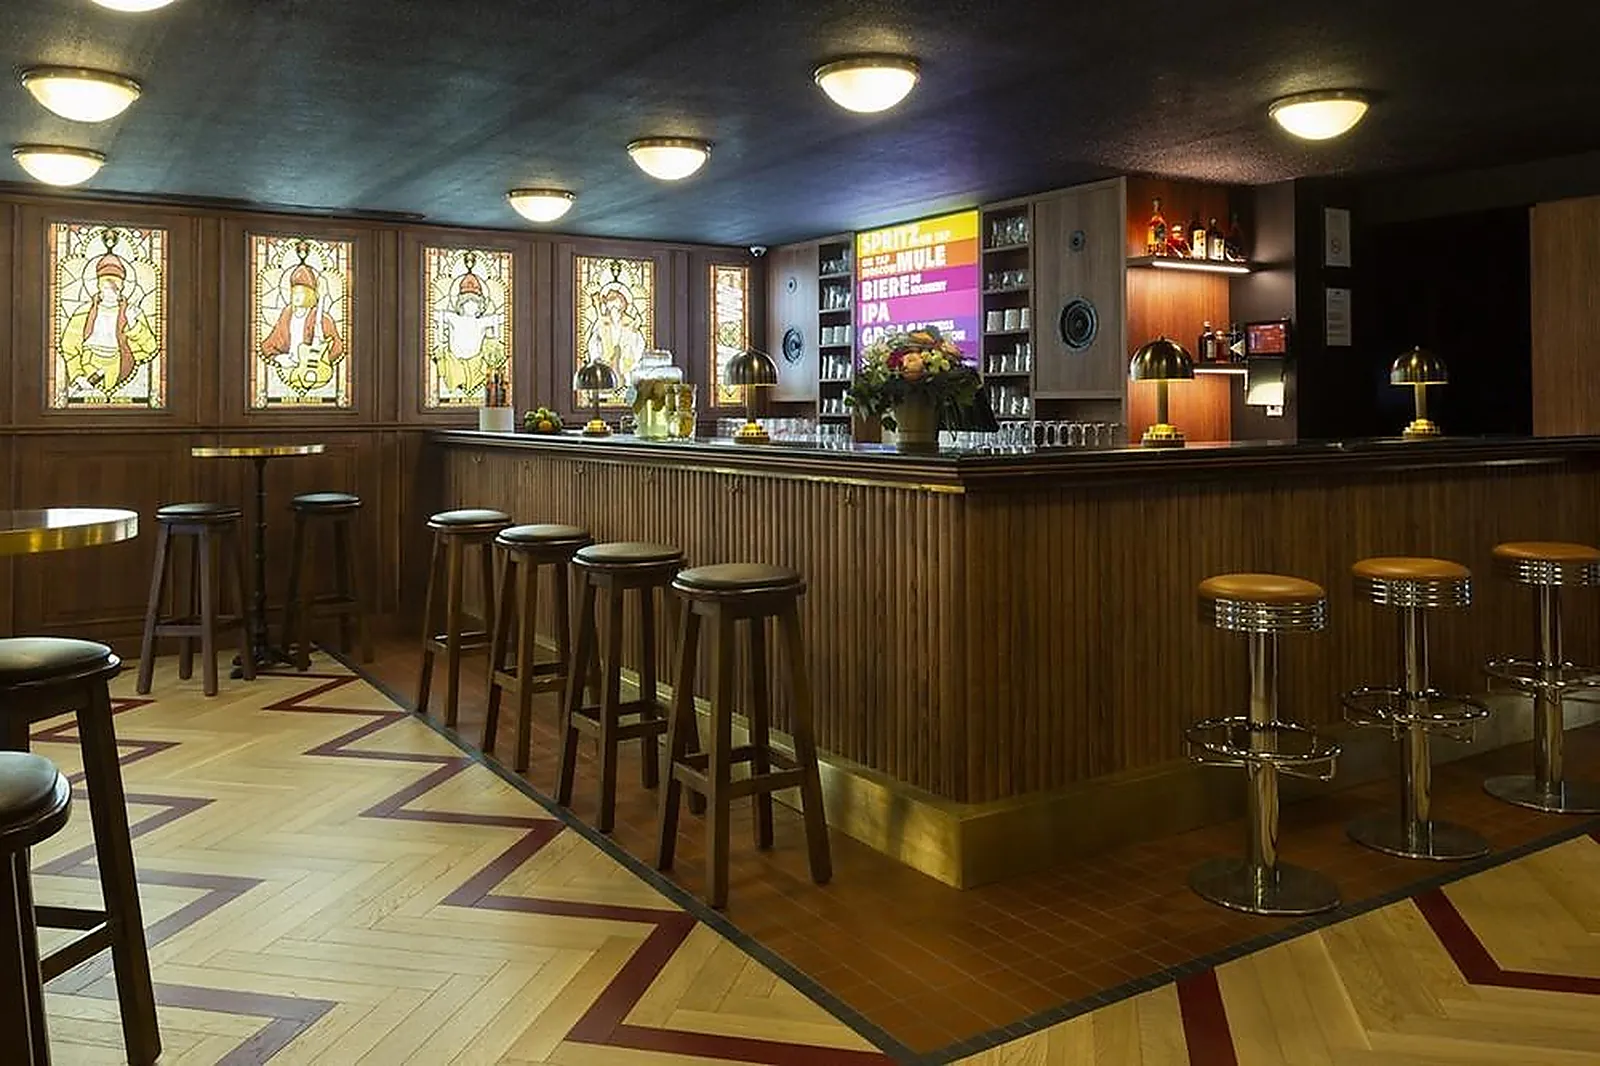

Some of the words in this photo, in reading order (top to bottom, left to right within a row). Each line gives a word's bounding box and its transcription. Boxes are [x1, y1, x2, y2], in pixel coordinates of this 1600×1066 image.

[861, 223, 920, 254] SPRITZ
[896, 245, 946, 272] MULE
[862, 274, 910, 301] BIERE
[862, 301, 890, 325] IPA
